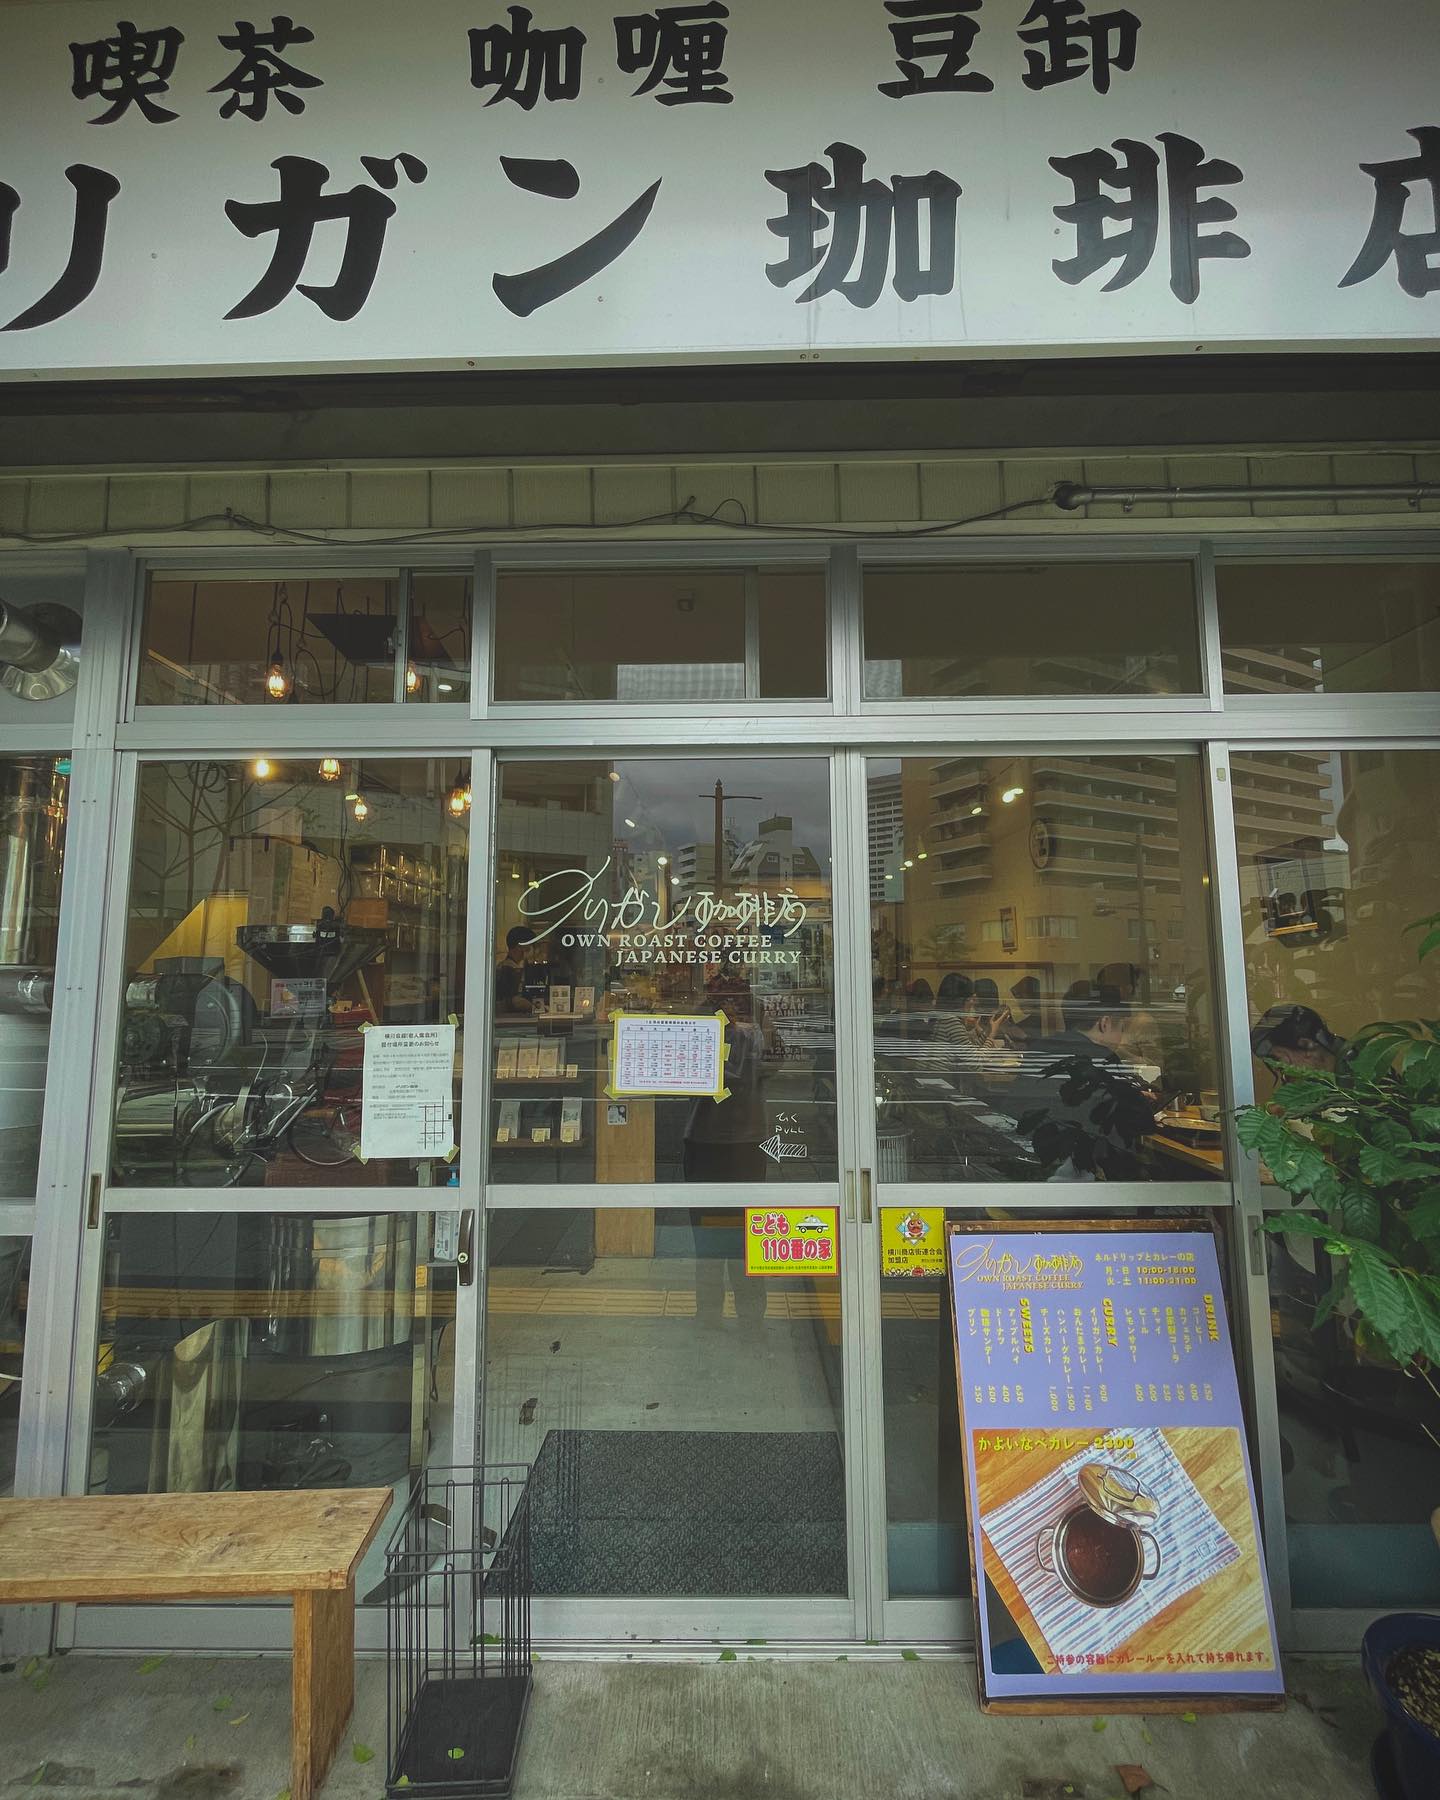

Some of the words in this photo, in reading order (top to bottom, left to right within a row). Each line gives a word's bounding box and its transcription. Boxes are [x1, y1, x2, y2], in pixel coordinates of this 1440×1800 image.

[69, 16, 324, 124] 喫茶
[468, 1, 733, 110] 咖喱
[877, 0, 1142, 98] 豆卸
[562, 934, 611, 948] OWN
[619, 934, 687, 948] ROAST
[694, 934, 772, 948] COFFEE
[615, 950, 721, 966] JAPANESE
[732, 950, 801, 964] CURRY
[750, 1212, 790, 1236] こども
[761, 1238, 833, 1262] 110番の家
[977, 1275, 1001, 1283] OWN
[1003, 1275, 1034, 1283] ROAST
[1036, 1274, 1071, 1282] COFFEE
[1003, 1282, 1050, 1292] JAPANESE
[1051, 1281, 1085, 1290] CURRY
[1019, 1297, 1035, 1354] SWEETS
[1102, 1297, 1119, 1348] CURRY
[1203, 1294, 1220, 1342] DRINK
[1093, 1436, 1135, 1450] 2300
